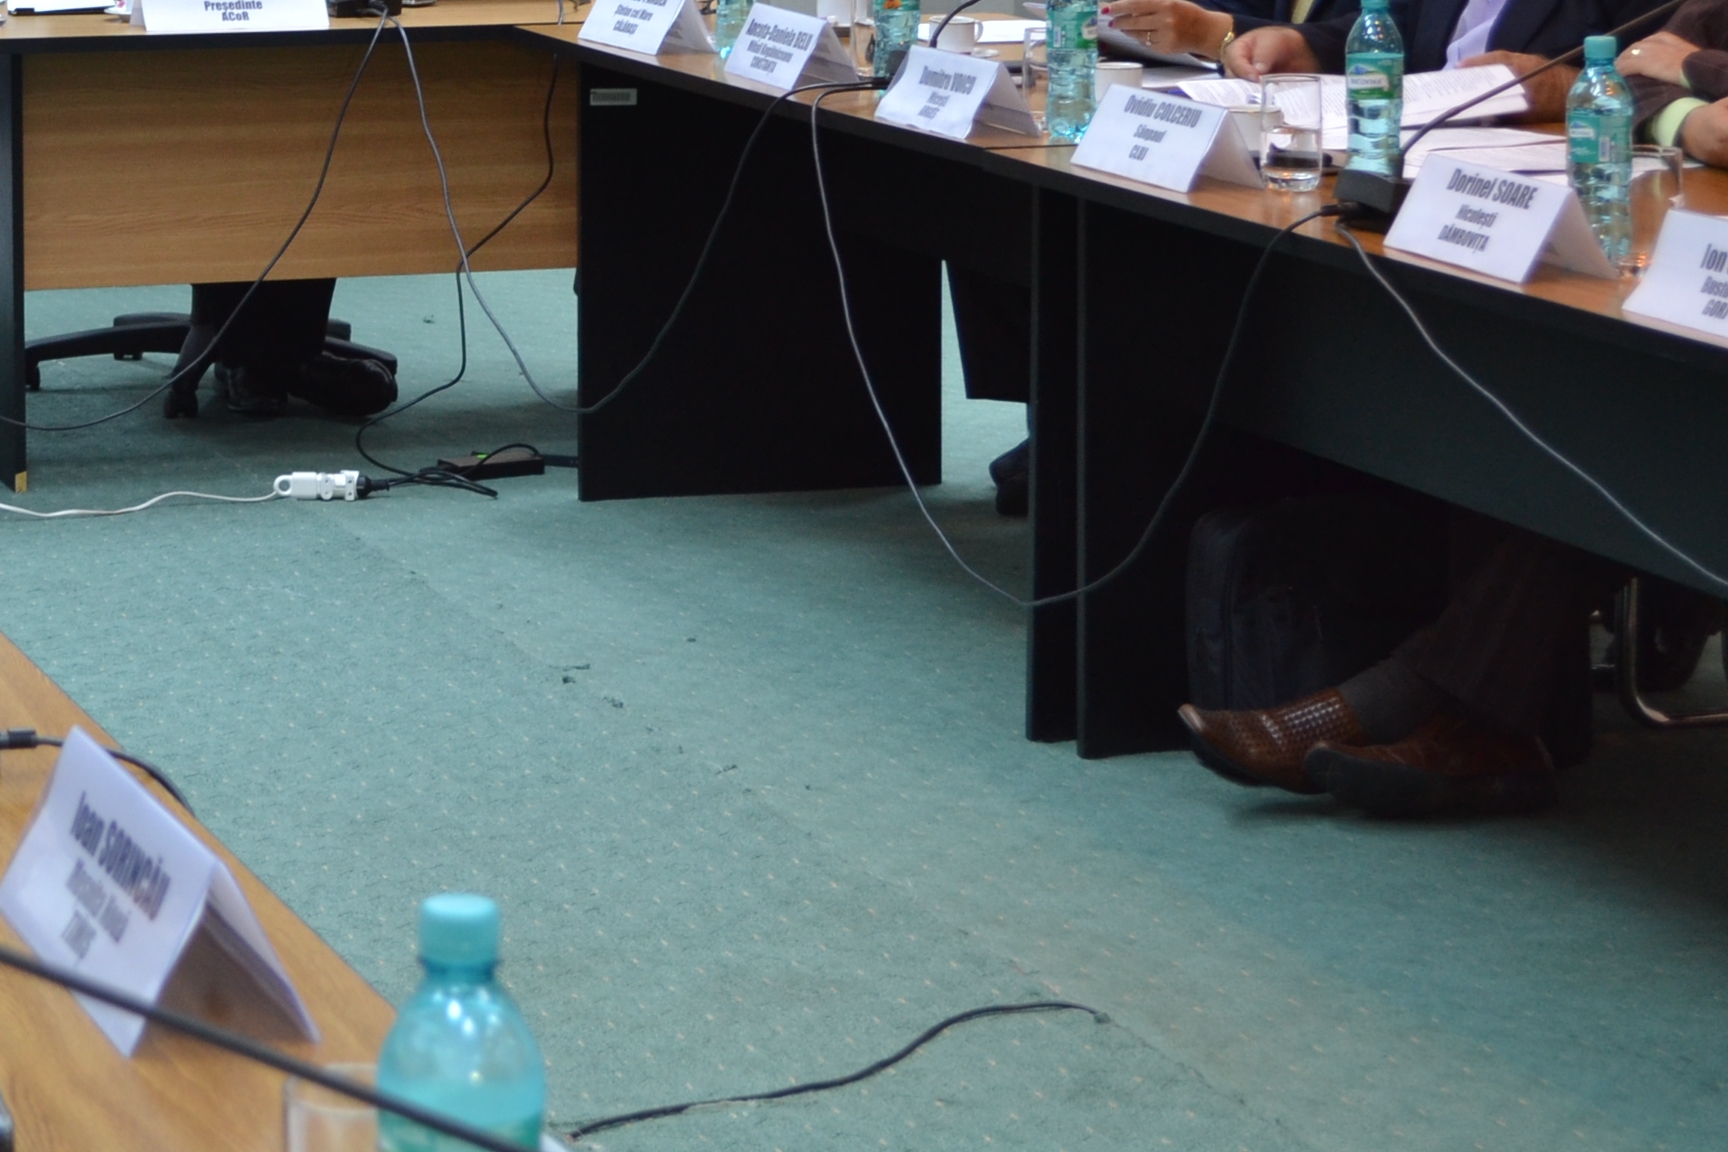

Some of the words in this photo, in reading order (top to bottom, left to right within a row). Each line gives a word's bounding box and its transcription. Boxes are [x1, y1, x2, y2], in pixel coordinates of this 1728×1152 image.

[1124, 95, 1157, 118] Ovidiu
[1446, 168, 1498, 199] Dorinel
[1492, 179, 1539, 210] SOARE
